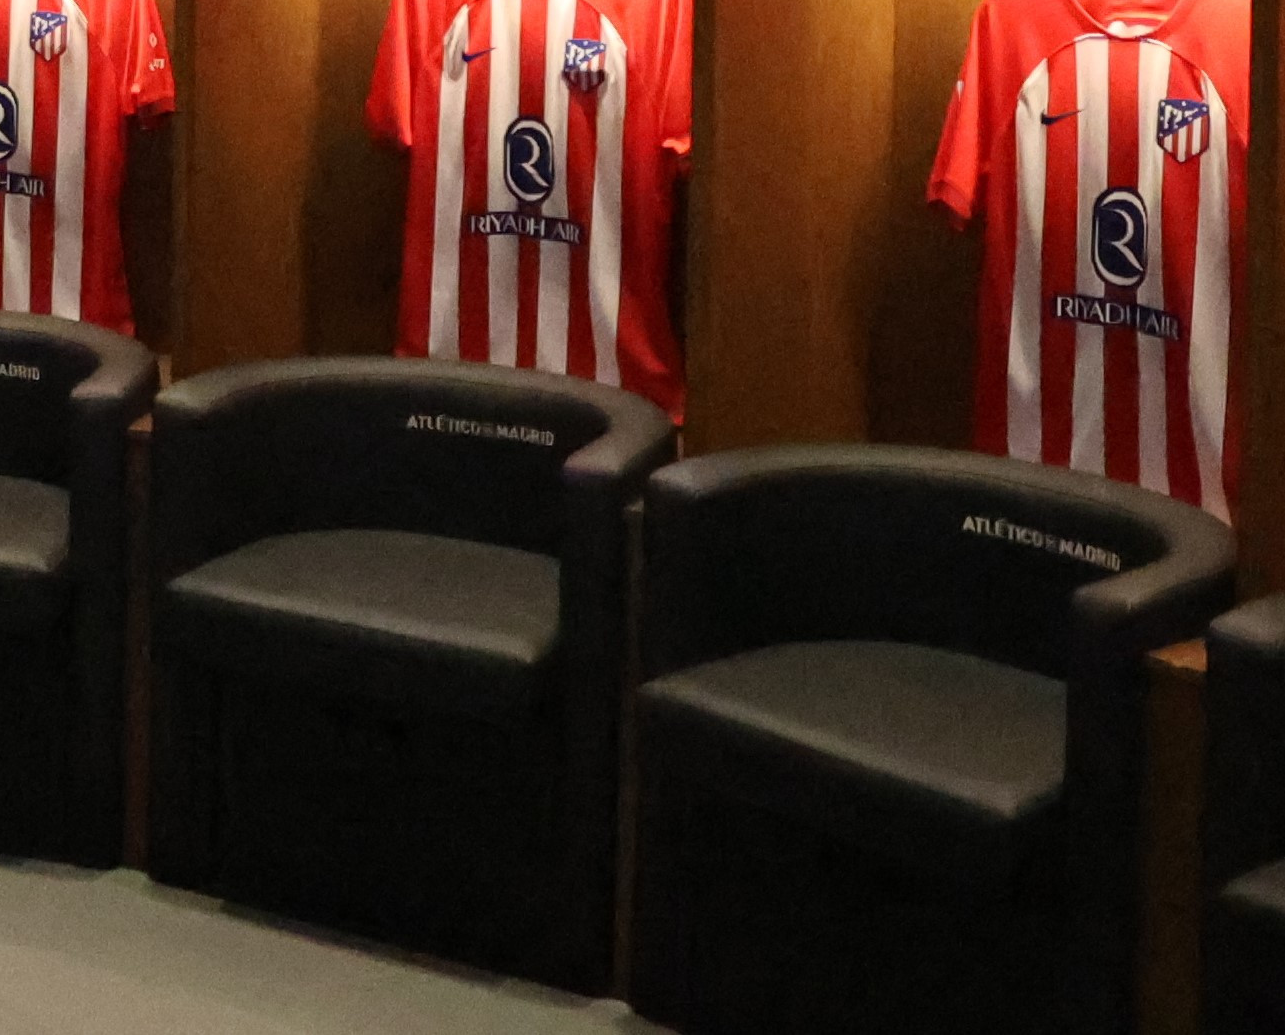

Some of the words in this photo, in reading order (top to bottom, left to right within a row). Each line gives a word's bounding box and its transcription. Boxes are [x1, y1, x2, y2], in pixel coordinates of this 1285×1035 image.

[17, 178, 45, 197] AIR
[471, 214, 546, 236] RIYADH
[552, 221, 580, 244] AIR
[1056, 296, 1141, 325] RIYADH
[1144, 314, 1178, 341] AIR
[407, 414, 481, 434] ATLÉTICO
[496, 423, 554, 446] MADRID
[963, 515, 1044, 549] ATLÉTICO
[1059, 537, 1121, 573] MADRID
